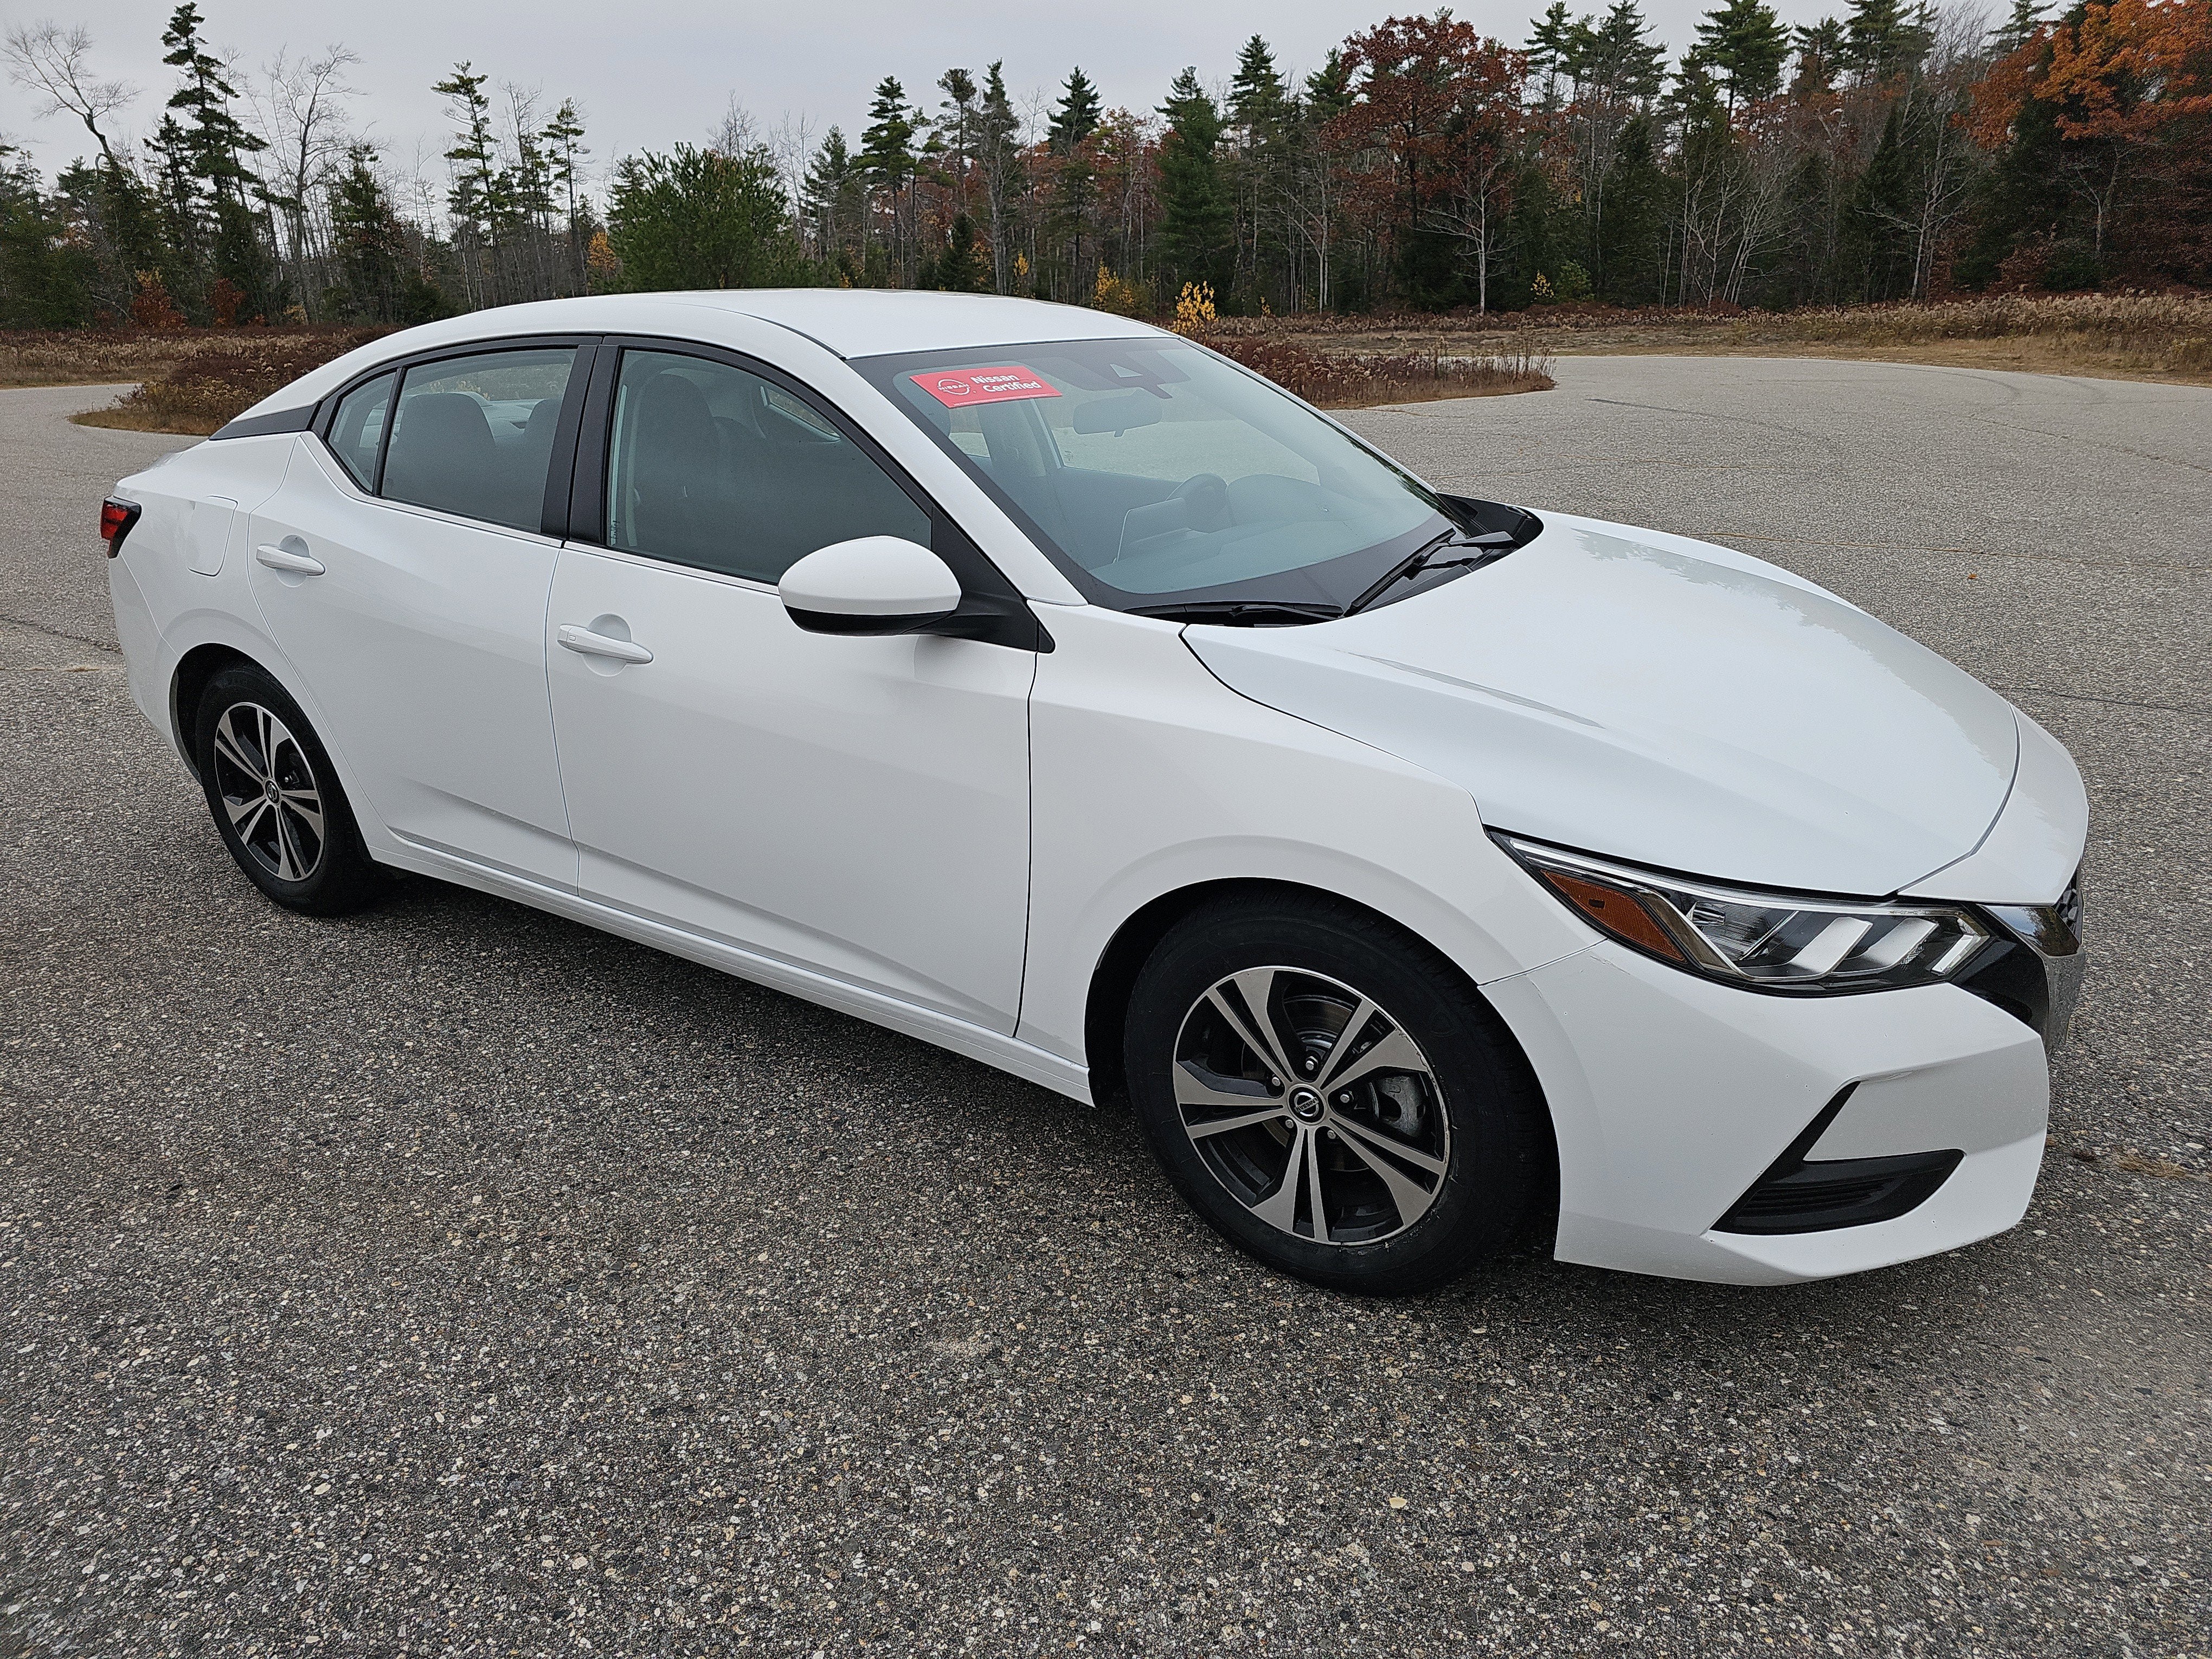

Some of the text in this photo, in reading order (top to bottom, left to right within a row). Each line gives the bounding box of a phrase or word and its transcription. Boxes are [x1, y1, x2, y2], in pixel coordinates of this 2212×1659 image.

[970, 374, 1020, 384] Nissan
[982, 381, 1042, 392] Certified
[1295, 1098, 1317, 1112] NISSAN
